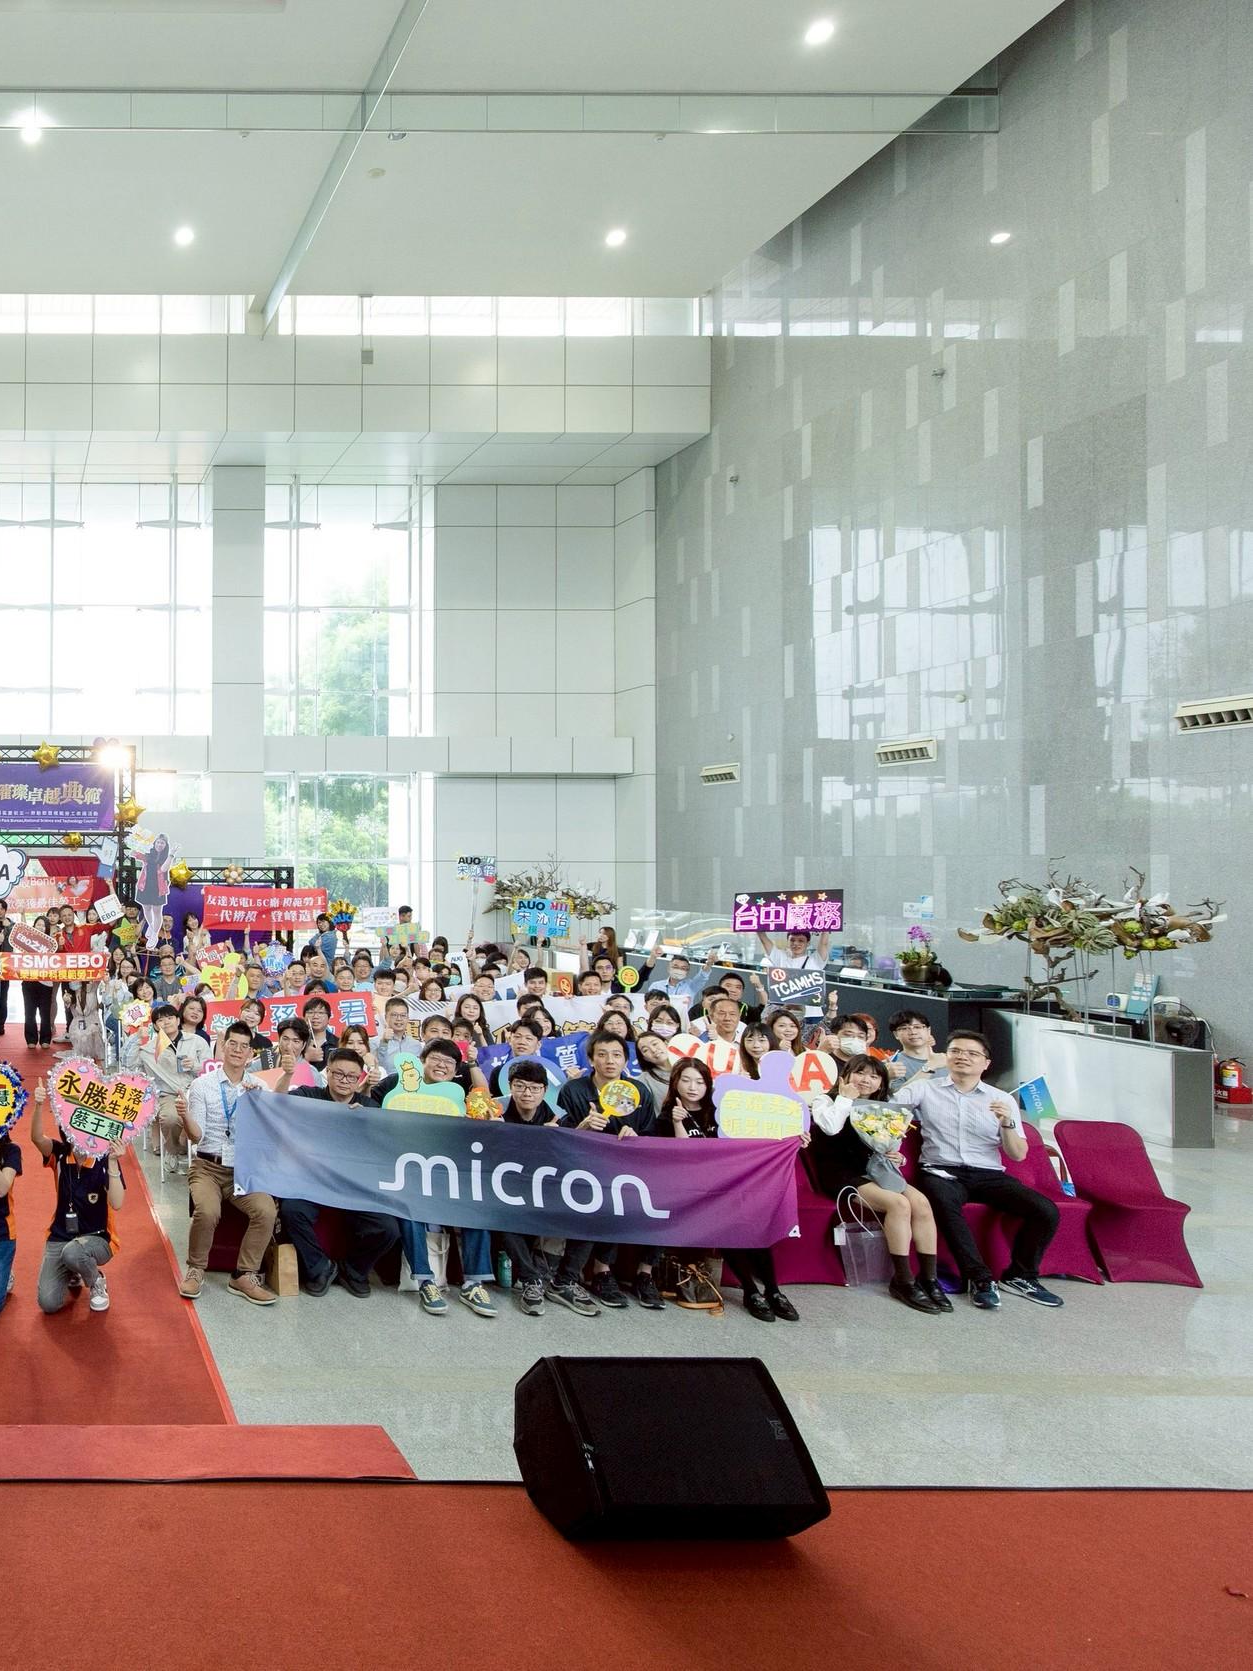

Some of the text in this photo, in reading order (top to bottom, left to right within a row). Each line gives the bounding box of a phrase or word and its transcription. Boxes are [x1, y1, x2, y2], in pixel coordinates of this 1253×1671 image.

[458, 856, 481, 865] AUO
[101, 911, 116, 922] EBO
[517, 900, 545, 911] AUO
[735, 902, 842, 931] 台中廠務
[11, 954, 104, 969] TSMC EBO
[770, 971, 824, 997] TCAMHS
[58, 1069, 108, 1110] 永勝
[113, 1082, 145, 1105] 角落
[1028, 1083, 1045, 1114] micron
[107, 1100, 140, 1122] 生物
[378, 1141, 670, 1219] micron
